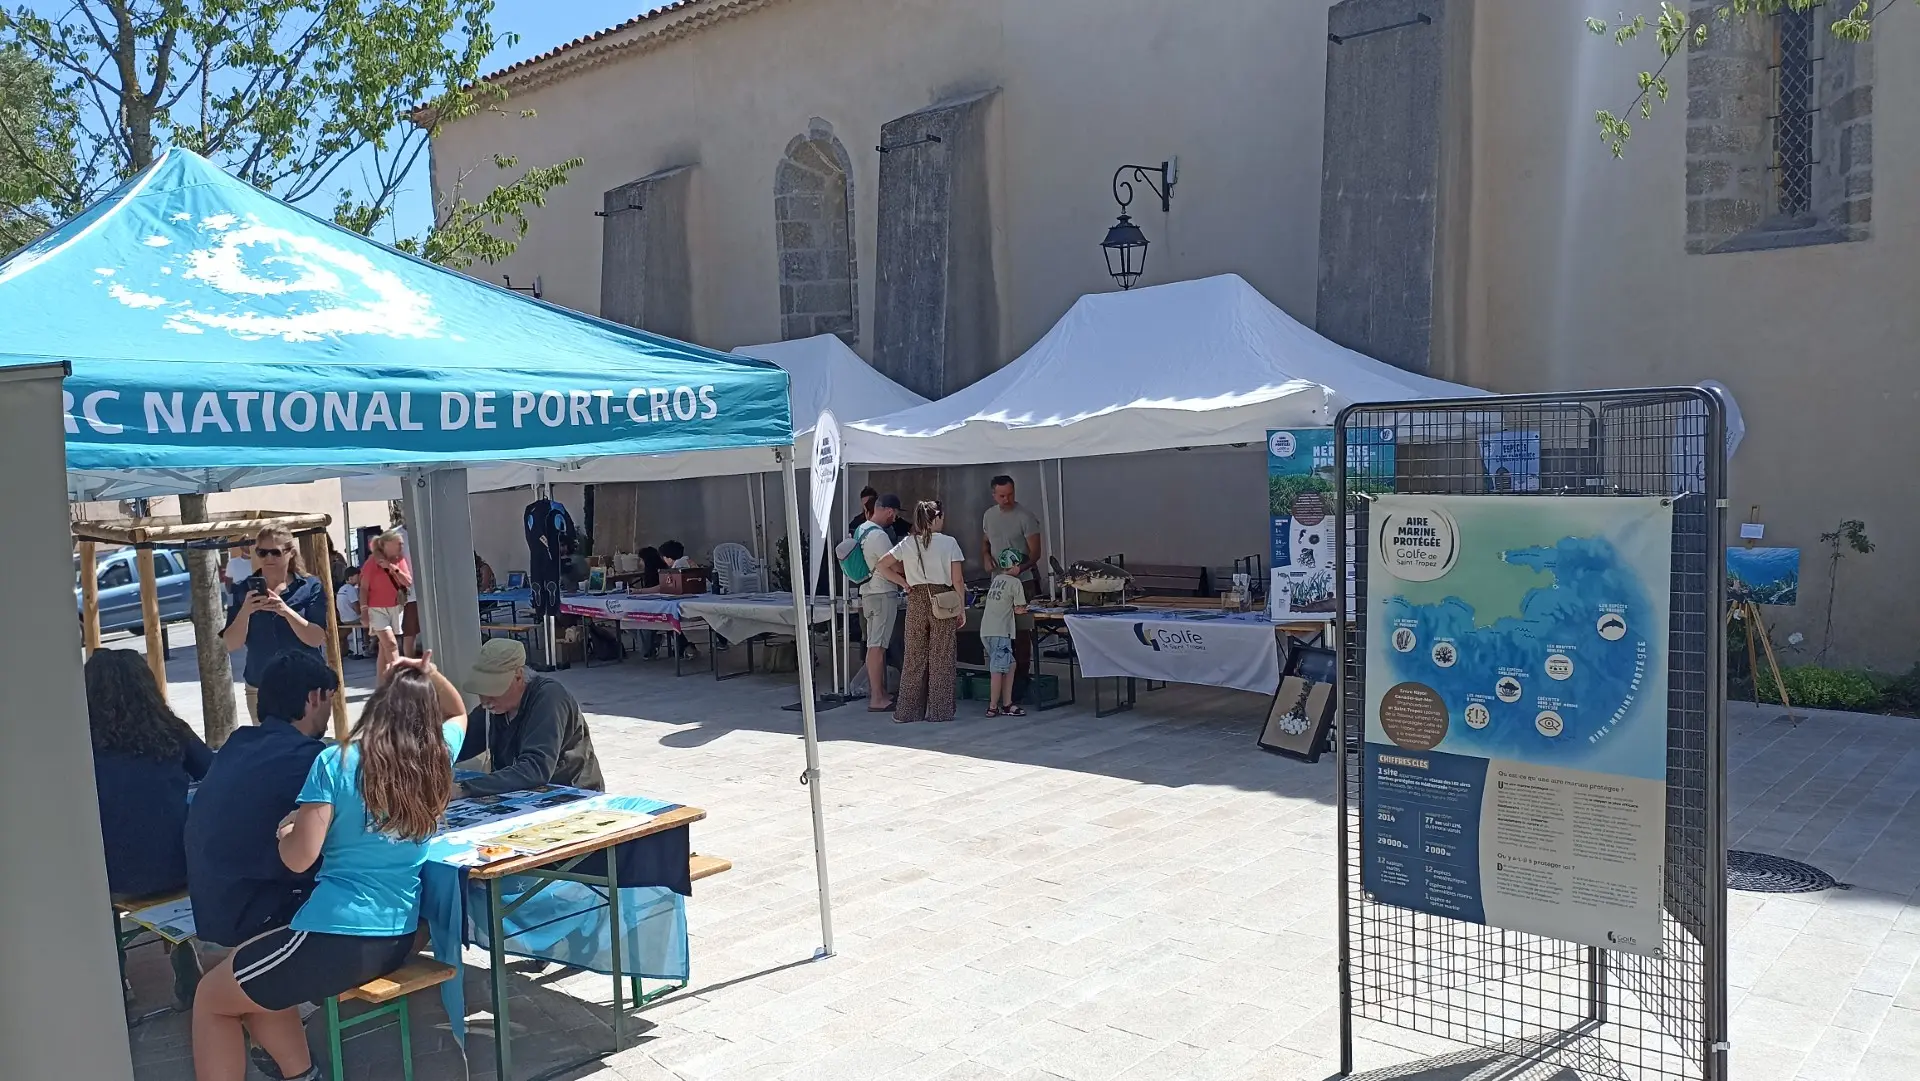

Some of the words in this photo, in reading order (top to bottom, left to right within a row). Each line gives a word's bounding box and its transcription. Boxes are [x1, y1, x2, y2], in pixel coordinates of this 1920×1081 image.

[63, 390, 123, 435] RC
[143, 390, 424, 434] NATIONAL
[440, 390, 496, 431] DE
[512, 384, 718, 428] PORT-CROS
[1406, 517, 1428, 526] AIRE
[1398, 527, 1436, 536] MARINE
[1394, 537, 1441, 547] PROTÉGÉE
[1397, 549, 1427, 559] Golfe
[1158, 629, 1203, 645] Golfe
[1379, 755, 1412, 766] CHIFFRES
[1412, 759, 1429, 769] CLÉS
[1383, 768, 1399, 777] site
[1377, 813, 1396, 822] 2014
[1425, 816, 1434, 824] 77
